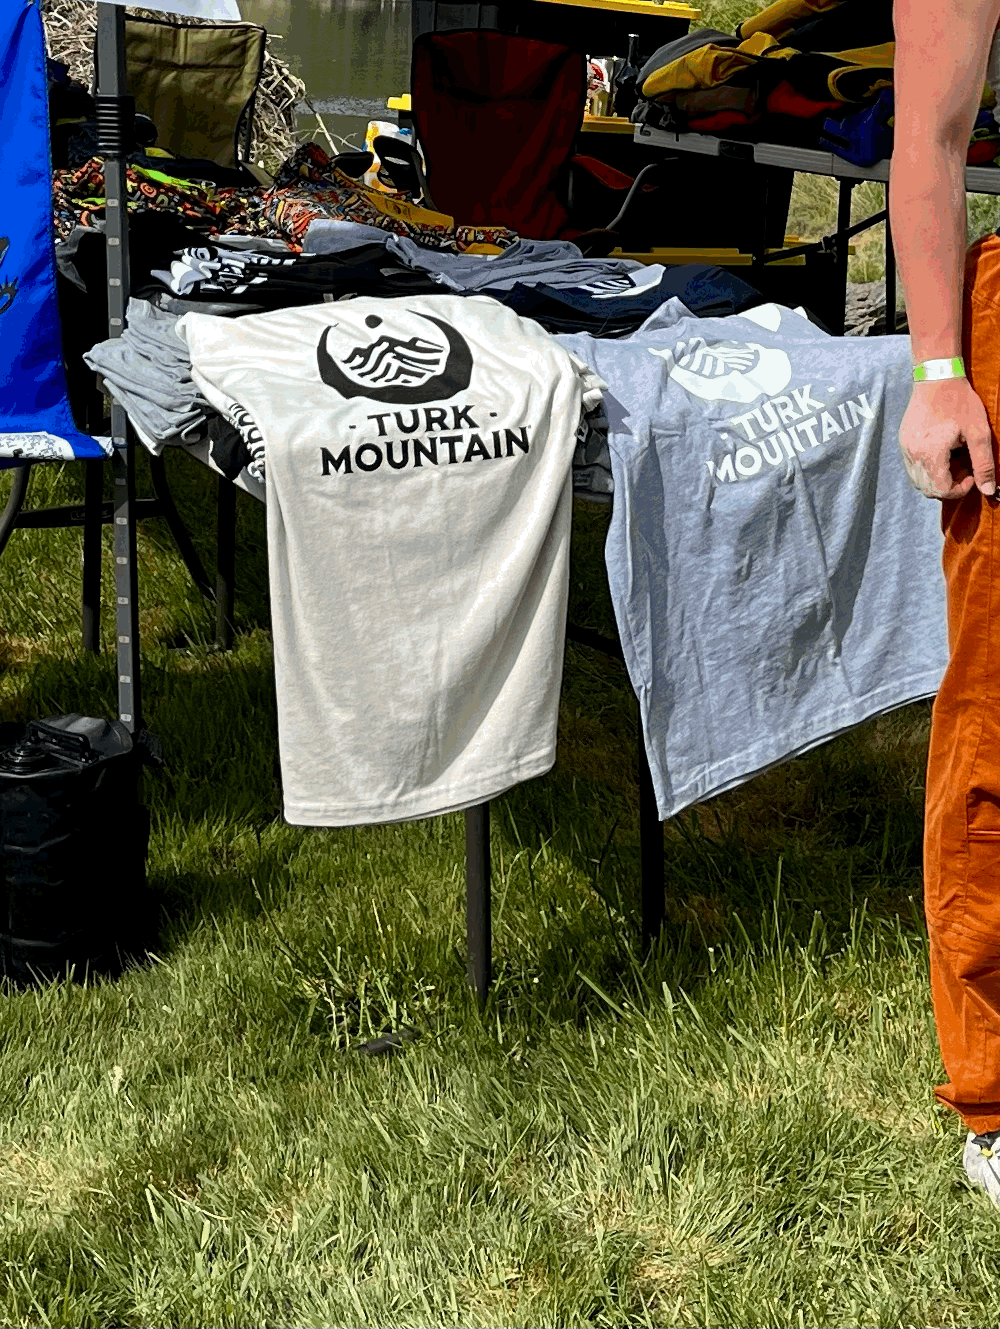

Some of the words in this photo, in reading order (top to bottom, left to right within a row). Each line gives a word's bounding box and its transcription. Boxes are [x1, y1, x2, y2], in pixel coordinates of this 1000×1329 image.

[367, 404, 481, 437] TURK
[705, 392, 876, 484] MOUNTAIN
[731, 383, 826, 441] TURK
[320, 425, 530, 477] MOUNTAIN
